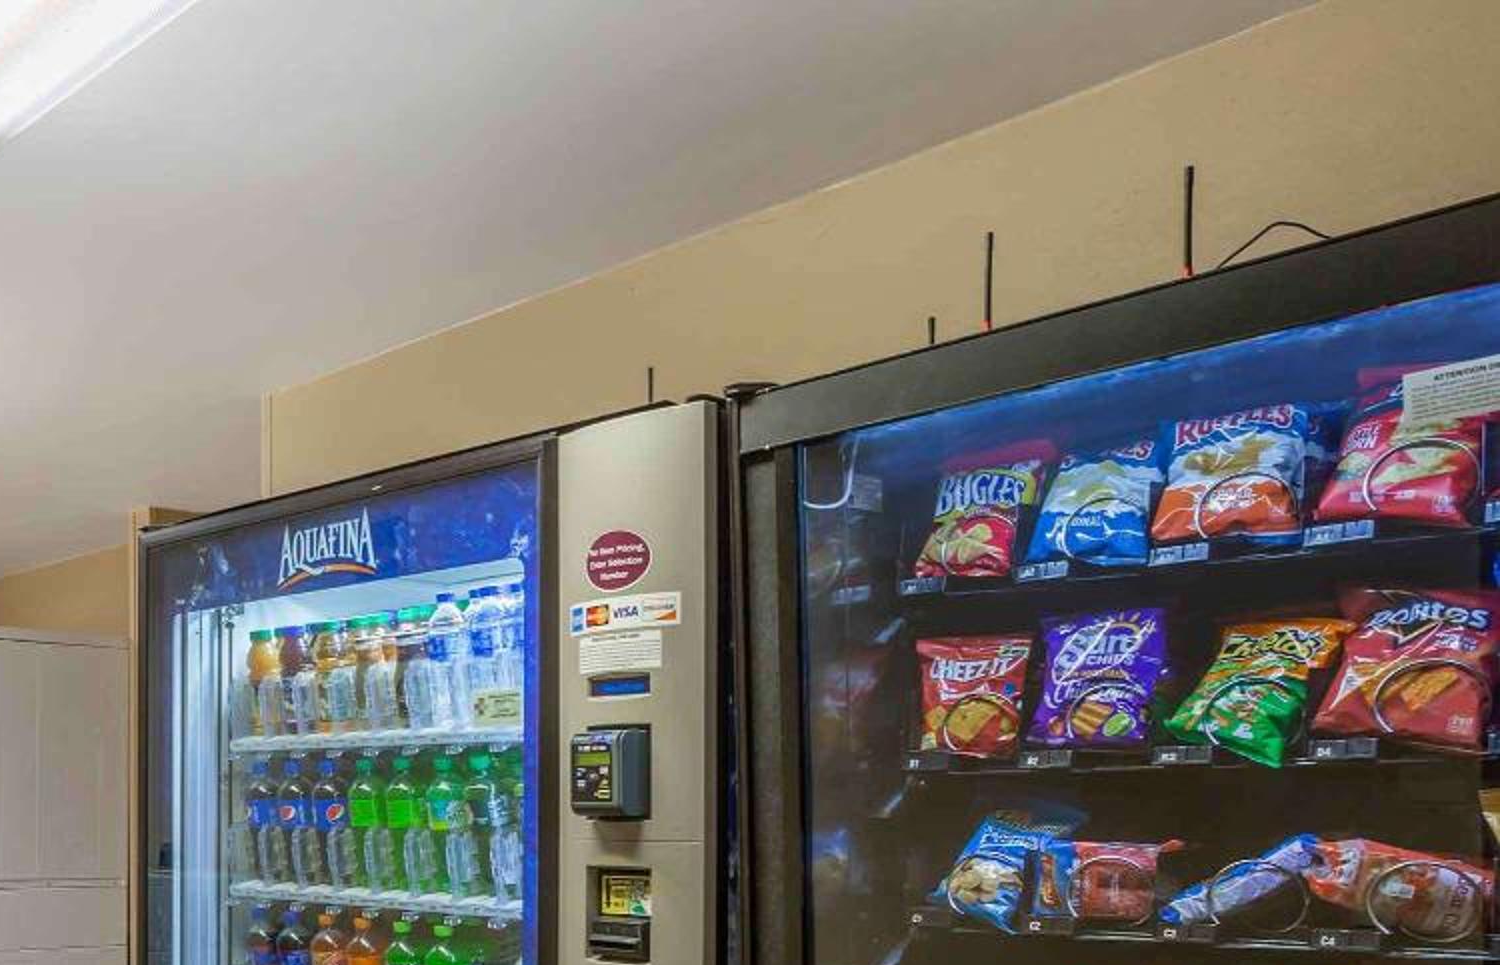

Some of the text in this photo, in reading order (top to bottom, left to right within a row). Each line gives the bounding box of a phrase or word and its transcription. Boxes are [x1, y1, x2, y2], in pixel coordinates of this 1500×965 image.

[935, 471, 1027, 516] BUGLES
[277, 508, 377, 584] AQUAFINA
[613, 605, 639, 619] VISA
[931, 656, 1013, 682] CHEEZ-IT
